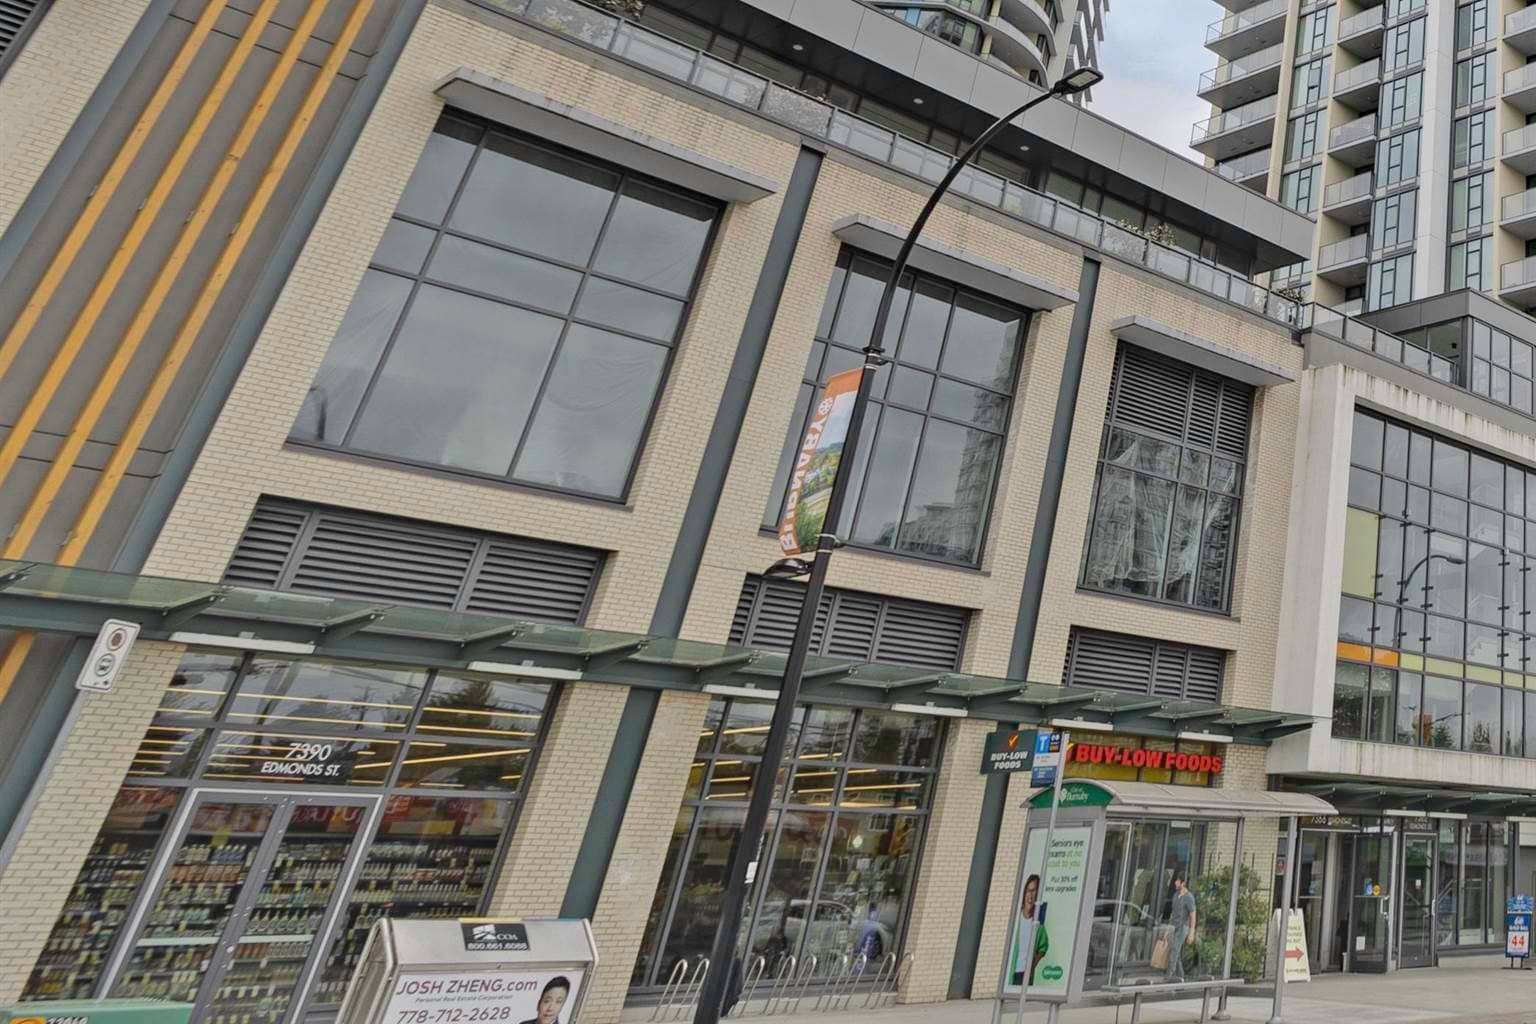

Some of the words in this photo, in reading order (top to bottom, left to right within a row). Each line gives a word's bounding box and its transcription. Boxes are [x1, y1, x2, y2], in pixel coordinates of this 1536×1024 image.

[285, 743, 332, 761] 7390
[991, 751, 1028, 761] BUY-LOW
[1075, 743, 1163, 769] BUY-LOW
[1165, 752, 1223, 774] FOODS
[261, 761, 324, 776] EDMONDS
[325, 764, 341, 777] ST.
[993, 761, 1022, 770] FOODS
[396, 980, 444, 996] JOSH
[446, 979, 538, 994] ZHENG.com
[397, 1007, 510, 1024] 778-712-2628
